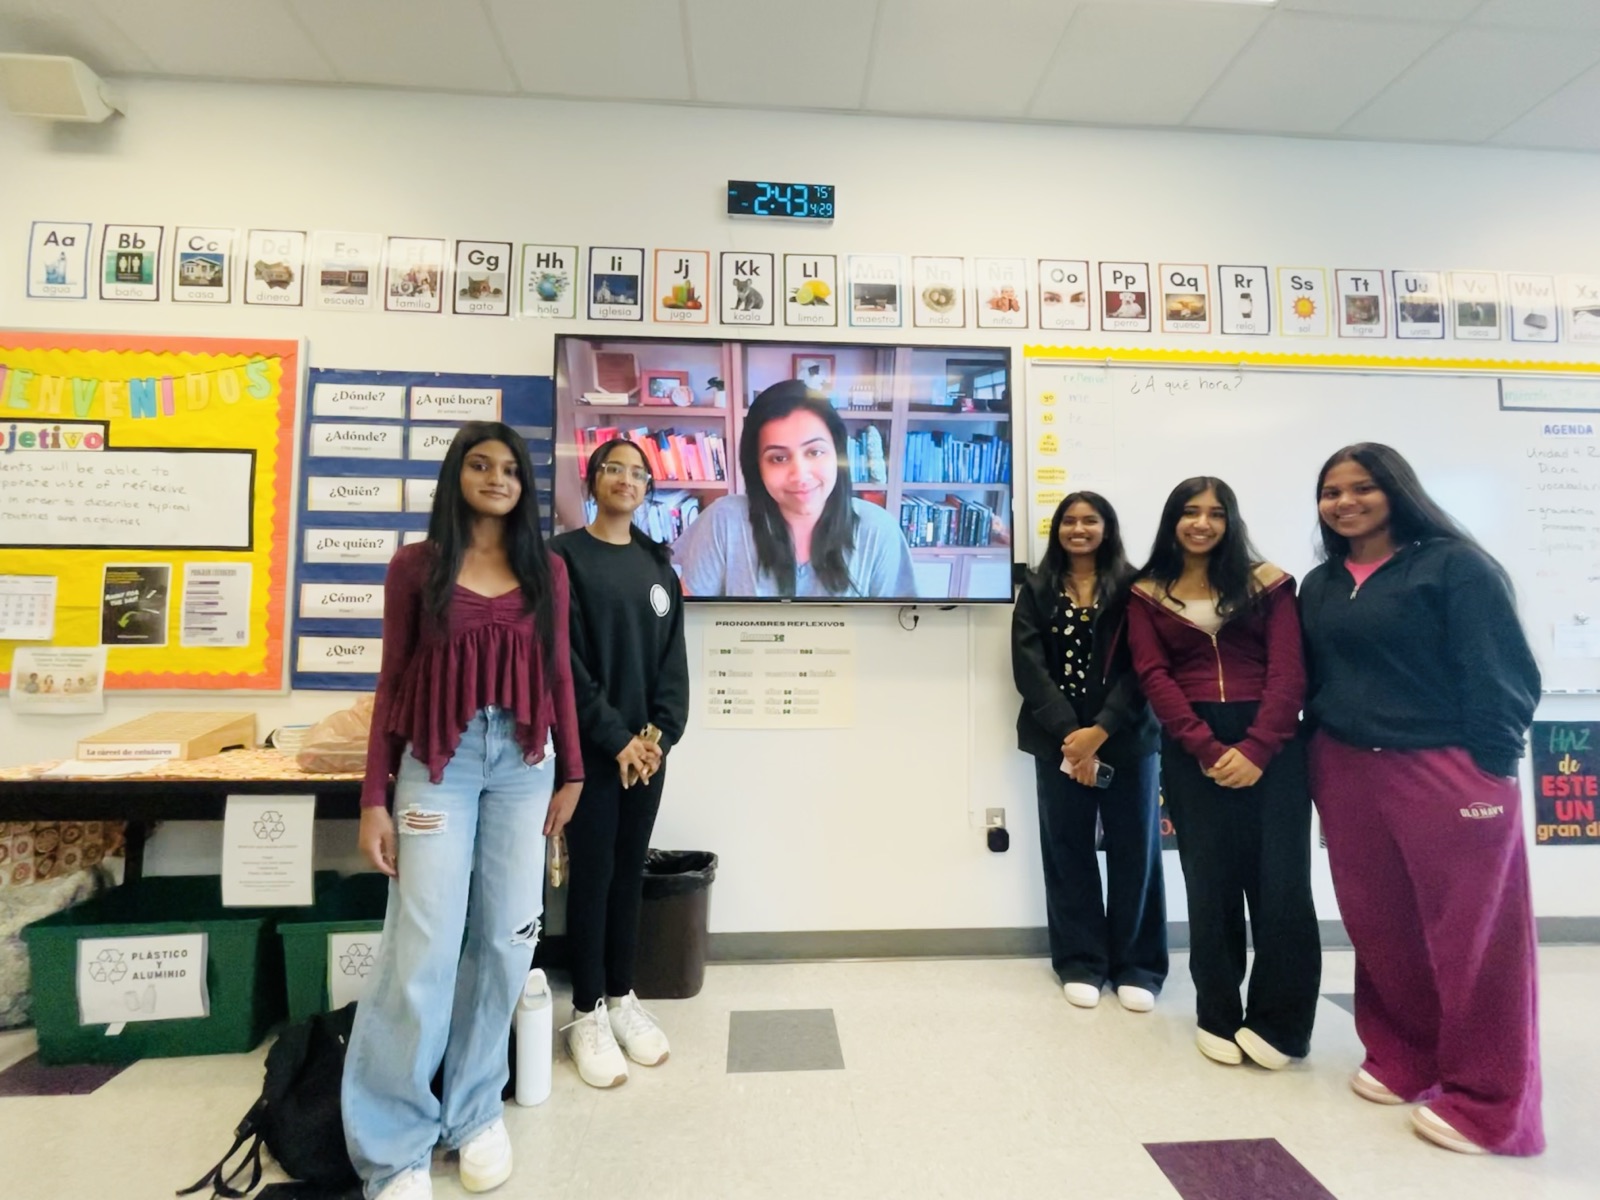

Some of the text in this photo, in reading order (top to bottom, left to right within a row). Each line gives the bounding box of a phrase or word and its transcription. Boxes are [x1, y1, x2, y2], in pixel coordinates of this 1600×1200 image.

[754, 183, 808, 216] 2:43
[44, 231, 76, 247] Aa
[118, 233, 146, 250] Bb
[188, 236, 219, 252] Cc
[467, 250, 499, 271] Gg
[536, 253, 563, 269] Hh
[674, 258, 690, 279] Jj
[735, 260, 760, 276] Kk
[1050, 268, 1078, 284] Oo
[1113, 270, 1136, 289] Pp
[1170, 272, 1198, 292] Qq
[1234, 274, 1253, 289] Rr
[43, 285, 71, 295] agua
[1290, 276, 1314, 291] Ss
[1350, 277, 1369, 292] Tt
[1405, 279, 1428, 293] Uu
[1463, 280, 1488, 293] Vv
[1515, 282, 1549, 297] Ww
[115, 286, 143, 297] baño
[188, 290, 214, 299] casa
[256, 292, 290, 302] dinero
[1575, 284, 1598, 300] Xx
[324, 295, 364, 306] escuela
[395, 299, 431, 309] familia
[469, 302, 493, 312] gato
[537, 304, 559, 315] hola
[598, 306, 632, 317] iglesia
[669, 309, 692, 320] jugo
[733, 311, 761, 321] koala
[798, 312, 824, 323] limón
[856, 313, 896, 323] maestro
[929, 313, 950, 324] nido
[993, 315, 1013, 325] niño
[1055, 317, 1075, 328] ojos
[1114, 319, 1139, 328] perro
[1172, 321, 1200, 331] queso
[1352, 325, 1373, 335] tigre
[1131, 375, 1243, 395] ¿A qué hora?
[332, 390, 386, 402] ¿Dónde?
[416, 394, 493, 407] ¿A qué hora?
[1544, 425, 1594, 435] AGENDA
[325, 431, 387, 443] ¿Adónde?
[1527, 448, 1569, 459] Unidad
[41, 462, 68, 473] will
[76, 462, 95, 475] be
[103, 463, 141, 476] able
[151, 464, 170, 477] to
[1538, 462, 1579, 475] Diaria
[95, 479, 111, 490] of
[122, 479, 187, 495] reflexive
[329, 486, 380, 498] ¿Quién?
[84, 498, 140, 510] describe
[316, 538, 384, 552] ¿De quién?
[321, 593, 372, 605] ¿Cómo?
[326, 645, 365, 657] ¿Qué?
[1550, 725, 1592, 754] HAZ
[1558, 753, 1582, 775] de
[1541, 775, 1598, 798] ESTE
[1459, 804, 1504, 818] OLD NAVY
[1555, 800, 1595, 821] UN
[1537, 824, 1582, 841] gran
[156, 961, 162, 969] Y
[132, 969, 187, 980] ALUMINIO
